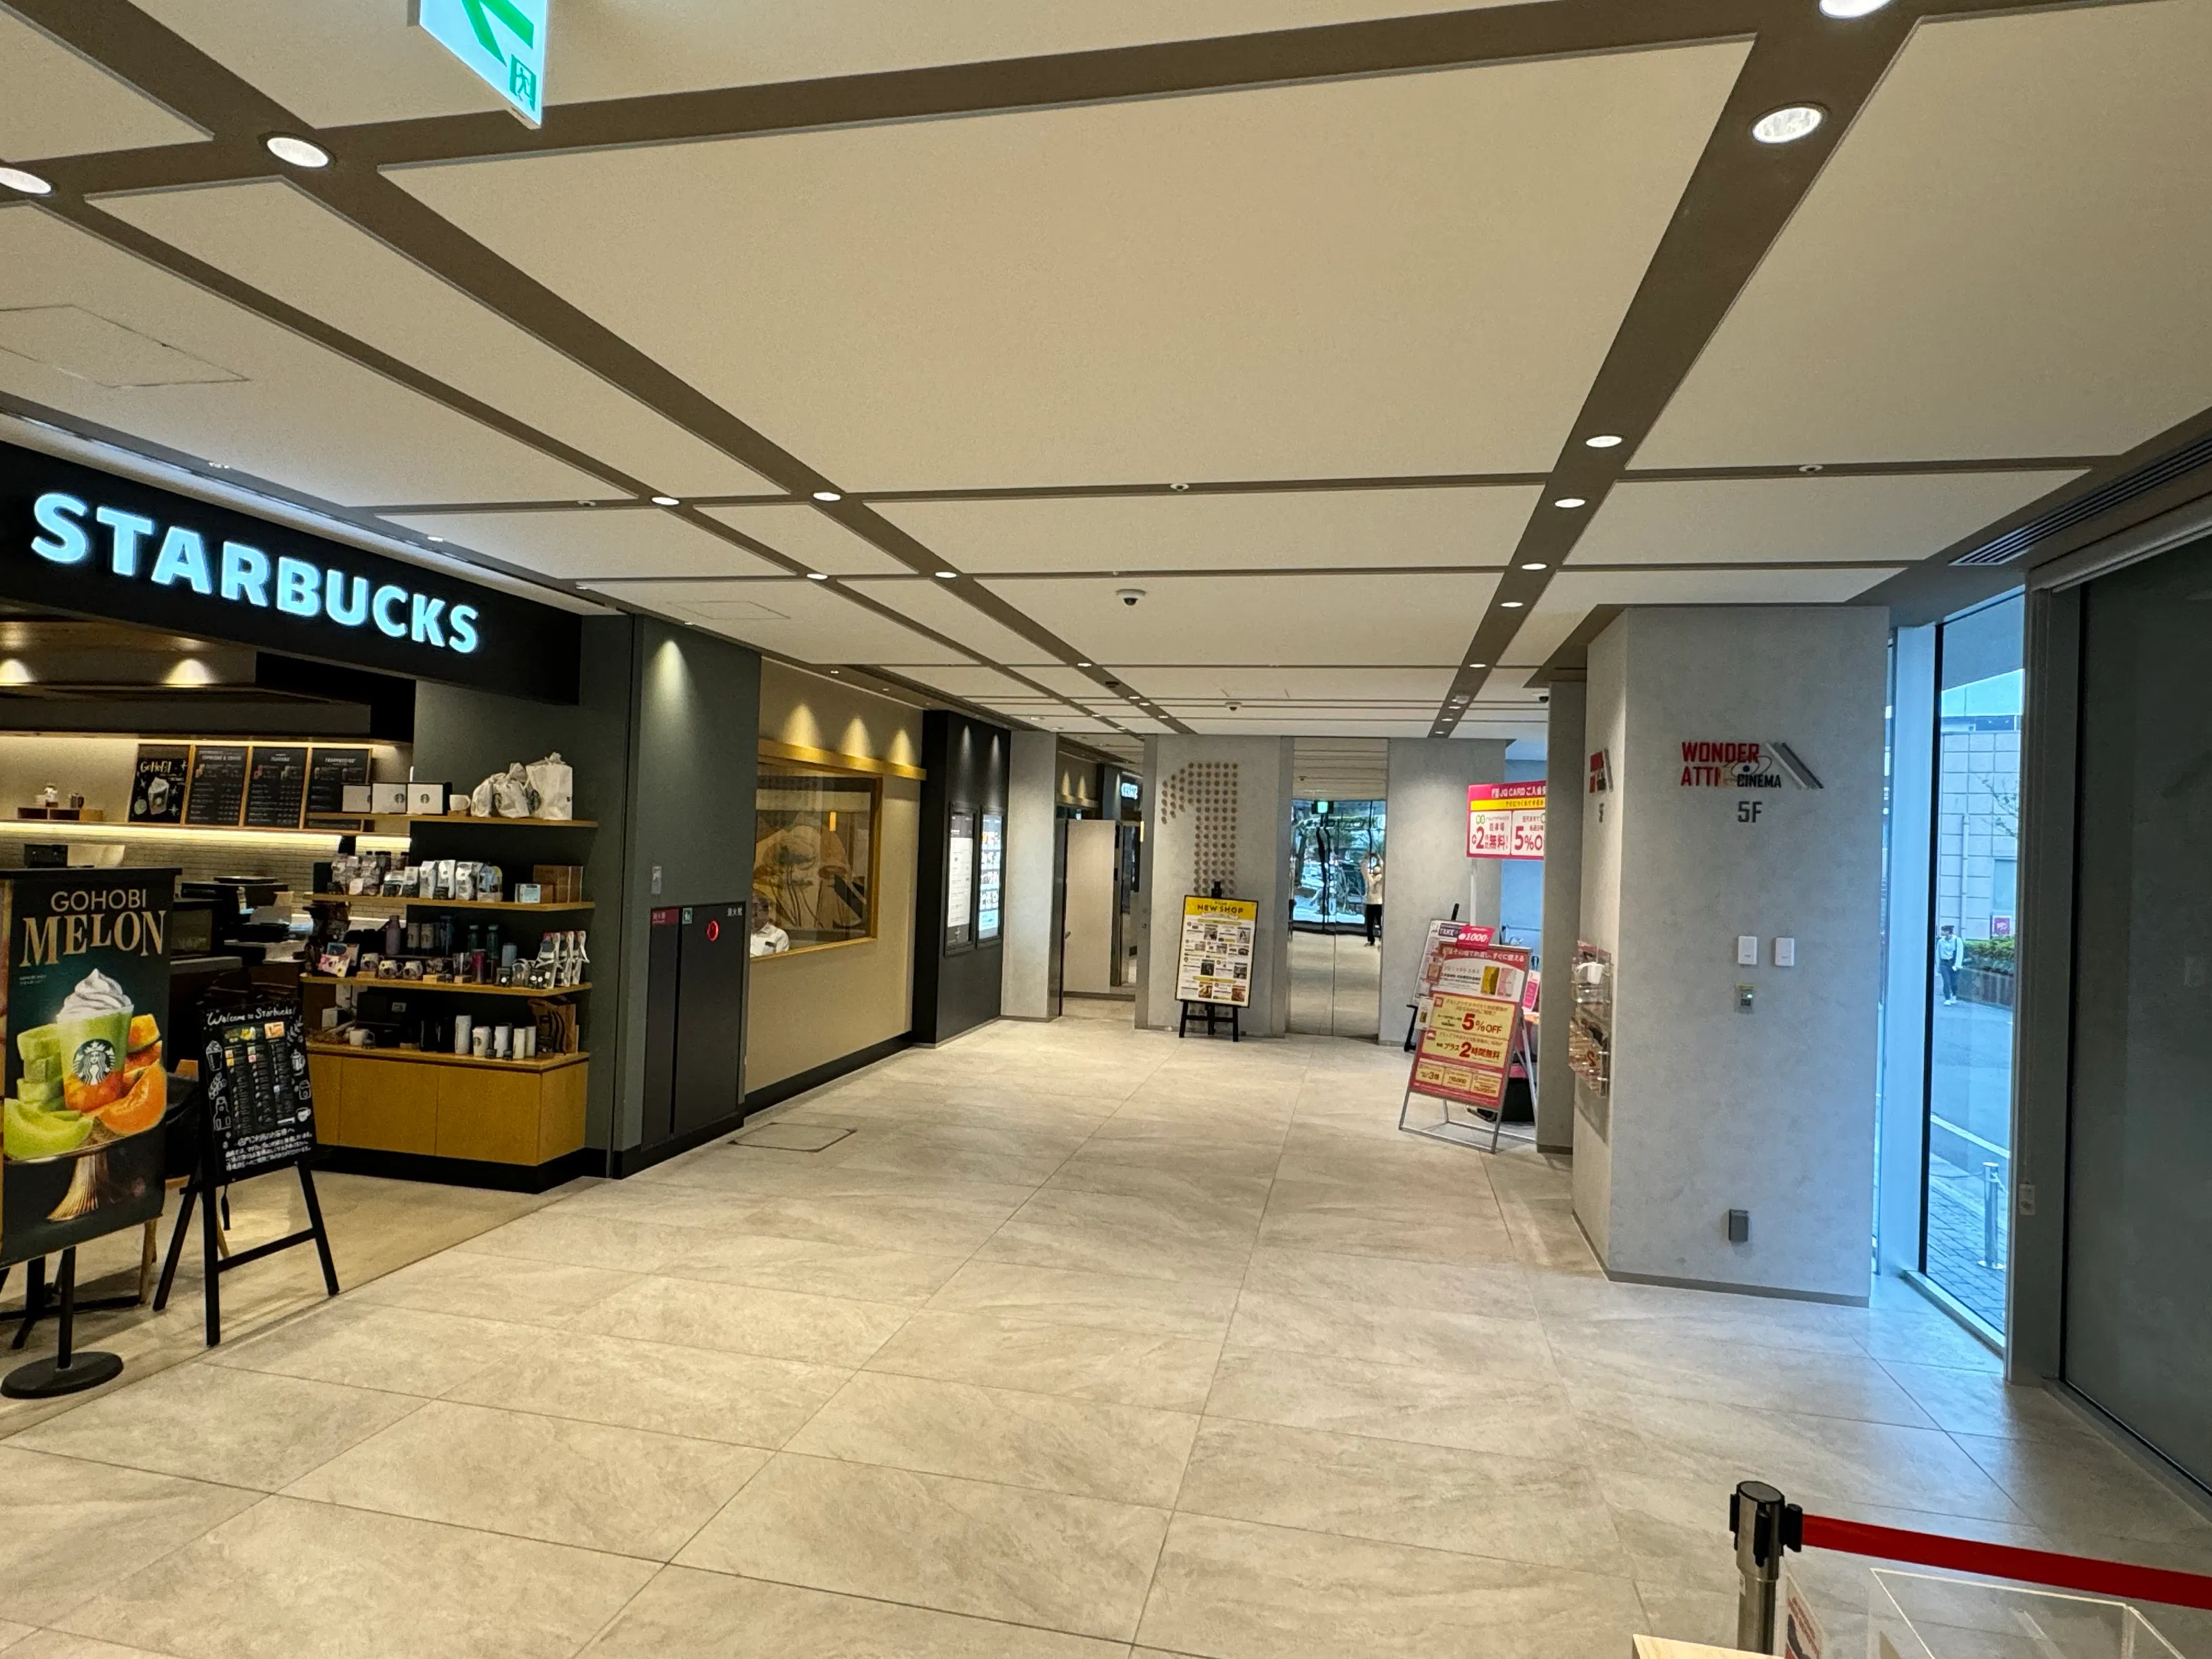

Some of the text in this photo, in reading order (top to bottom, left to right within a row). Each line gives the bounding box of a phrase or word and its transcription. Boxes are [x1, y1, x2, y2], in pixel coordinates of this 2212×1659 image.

[31, 493, 480, 653] STARBUCKS
[1681, 741, 1760, 763] WONDER
[1737, 773, 1782, 788] CINEMA
[1738, 800, 1763, 823] 5F
[51, 888, 147, 912] GOHOBI
[19, 910, 167, 967] MELON
